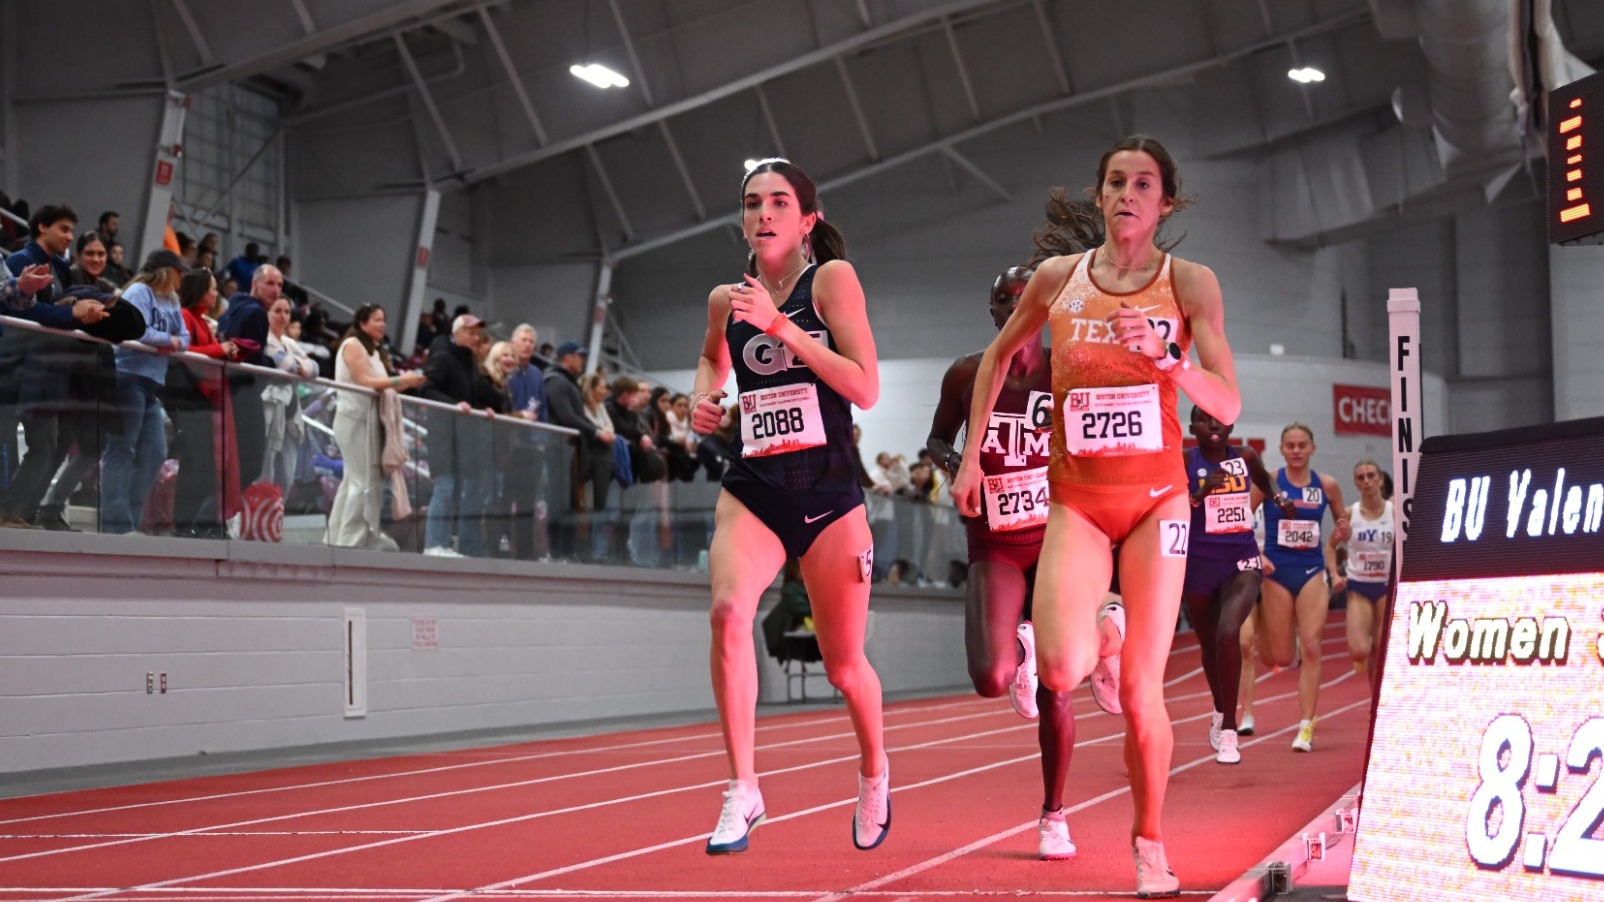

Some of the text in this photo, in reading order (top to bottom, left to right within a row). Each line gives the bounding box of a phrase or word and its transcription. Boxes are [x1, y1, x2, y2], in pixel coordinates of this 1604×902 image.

[1071, 318, 1120, 344] TEX
[752, 407, 805, 440] 2088
[1081, 410, 1143, 439] 2726
[1398, 335, 1414, 550] FINIS
[1199, 475, 1247, 494] SU
[1306, 488, 1320, 502] 20
[998, 486, 1049, 515] 2734
[1217, 506, 1246, 523] 2251
[1441, 467, 1604, 543] BU Valen
[1168, 522, 1187, 555] 22
[1285, 530, 1313, 543] 2042
[1358, 529, 1378, 543] BY
[1381, 531, 1393, 545] 19
[1408, 600, 1571, 666] Women
[1466, 712, 1604, 878] 8:2
